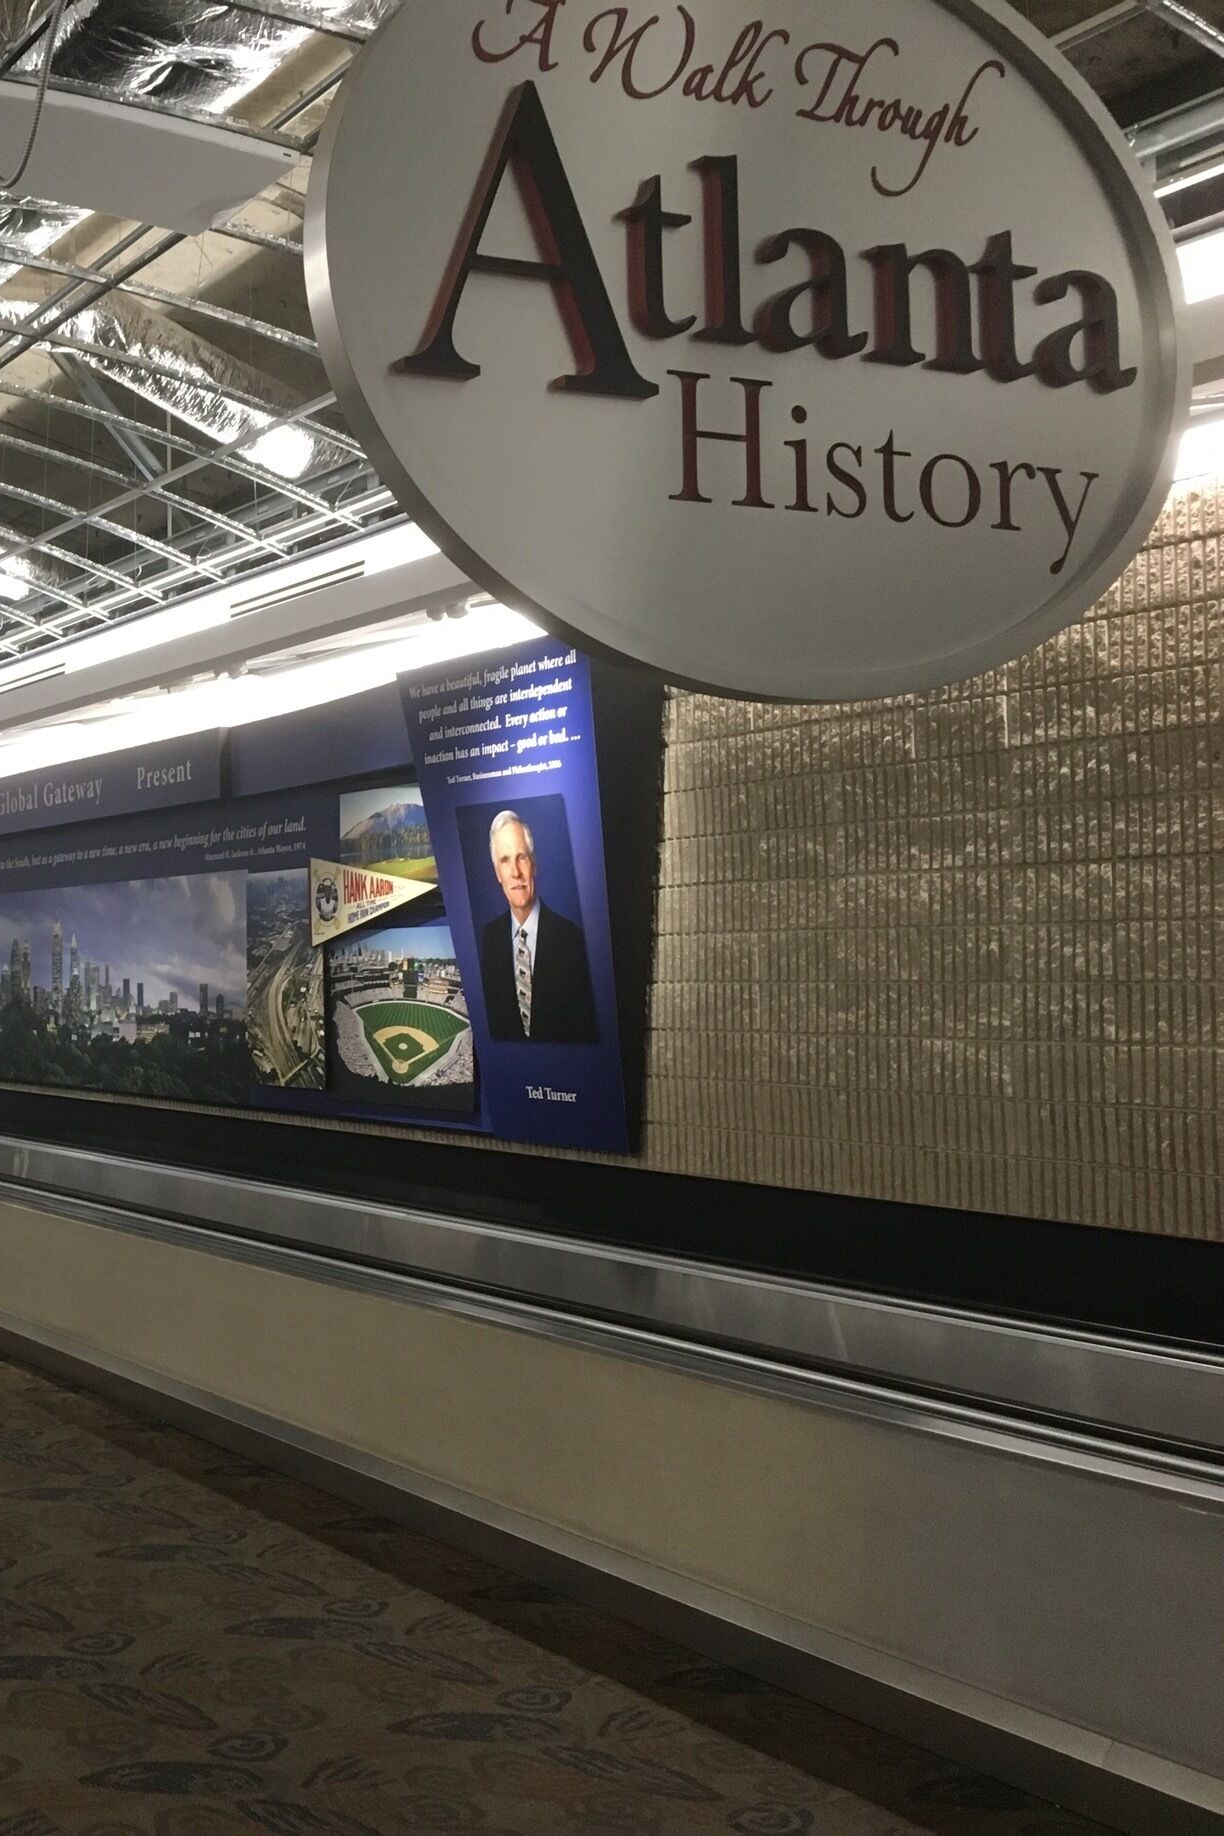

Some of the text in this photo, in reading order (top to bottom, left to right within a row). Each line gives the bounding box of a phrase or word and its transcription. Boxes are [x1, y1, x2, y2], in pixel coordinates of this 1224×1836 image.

[472, 0, 1006, 197] A Walk Through
[388, 79, 1139, 400] Atlanta
[667, 369, 1100, 575] History
[409, 648, 576, 698] We have a beautiful, fragile planet where all
[419, 677, 572, 725] people and all things are interdependent
[429, 706, 568, 741] and interconnected. Every action or
[424, 749, 454, 765] inaction
[455, 746, 469, 761] has
[470, 746, 480, 758] an
[481, 740, 509, 758] impact
[516, 732, 537, 754] good
[537, 734, 548, 746] or
[548, 727, 569, 745] bad.
[43, 778, 103, 806] Gateway
[136, 759, 192, 790] Present
[124, 843, 137, 854] new
[158, 839, 173, 850] new
[173, 832, 209, 852] beginning
[208, 828, 222, 849] for
[222, 827, 234, 841] the
[236, 824, 257, 840] cities
[258, 821, 269, 841] of
[268, 823, 283, 836] our
[284, 816, 307, 833] land.
[343, 869, 393, 904] HANK AARON
[525, 1086, 576, 1102] Ted Turner
